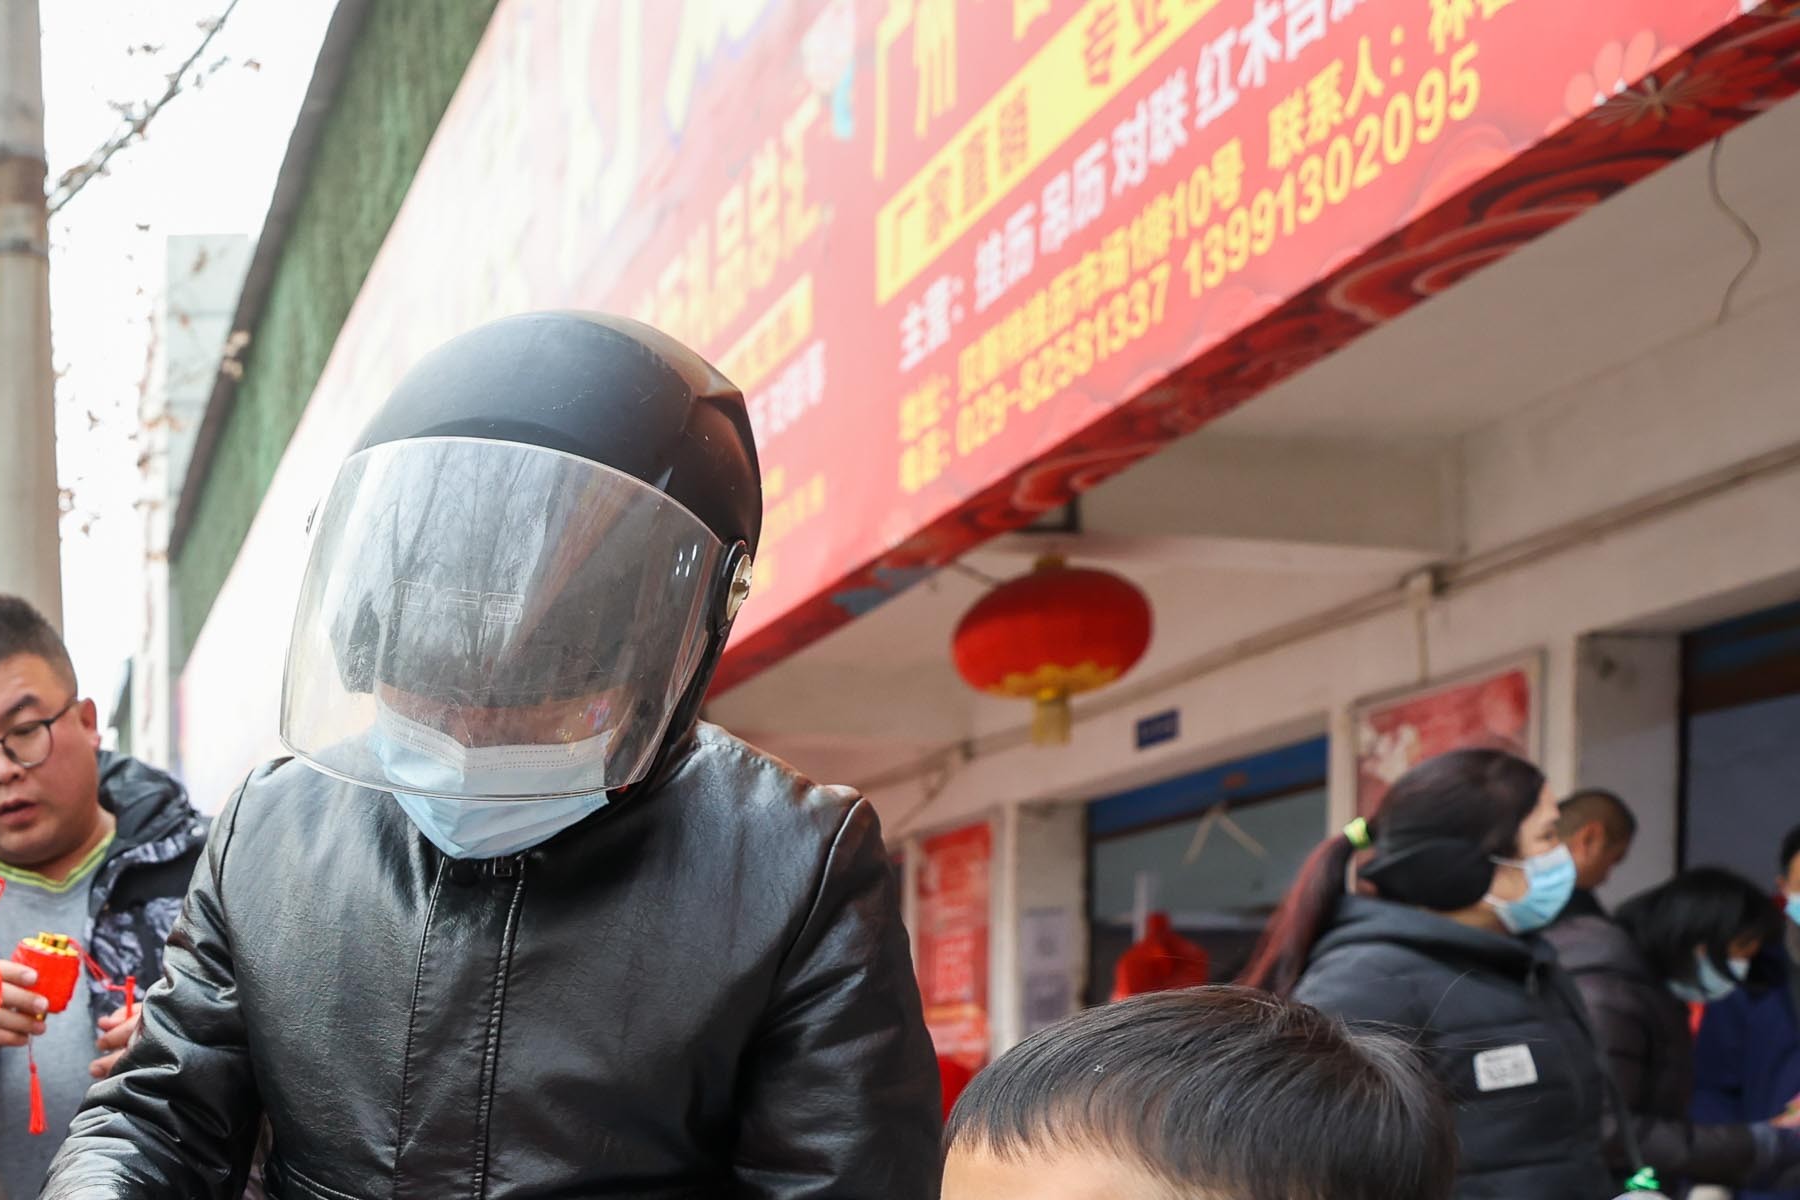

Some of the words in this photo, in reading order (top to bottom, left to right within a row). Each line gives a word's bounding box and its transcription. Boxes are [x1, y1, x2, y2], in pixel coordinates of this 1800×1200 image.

[1111, 66, 1188, 196] 对联
[1194, 0, 1365, 130] 红木台
[1180, 40, 1481, 298] 13991302095
